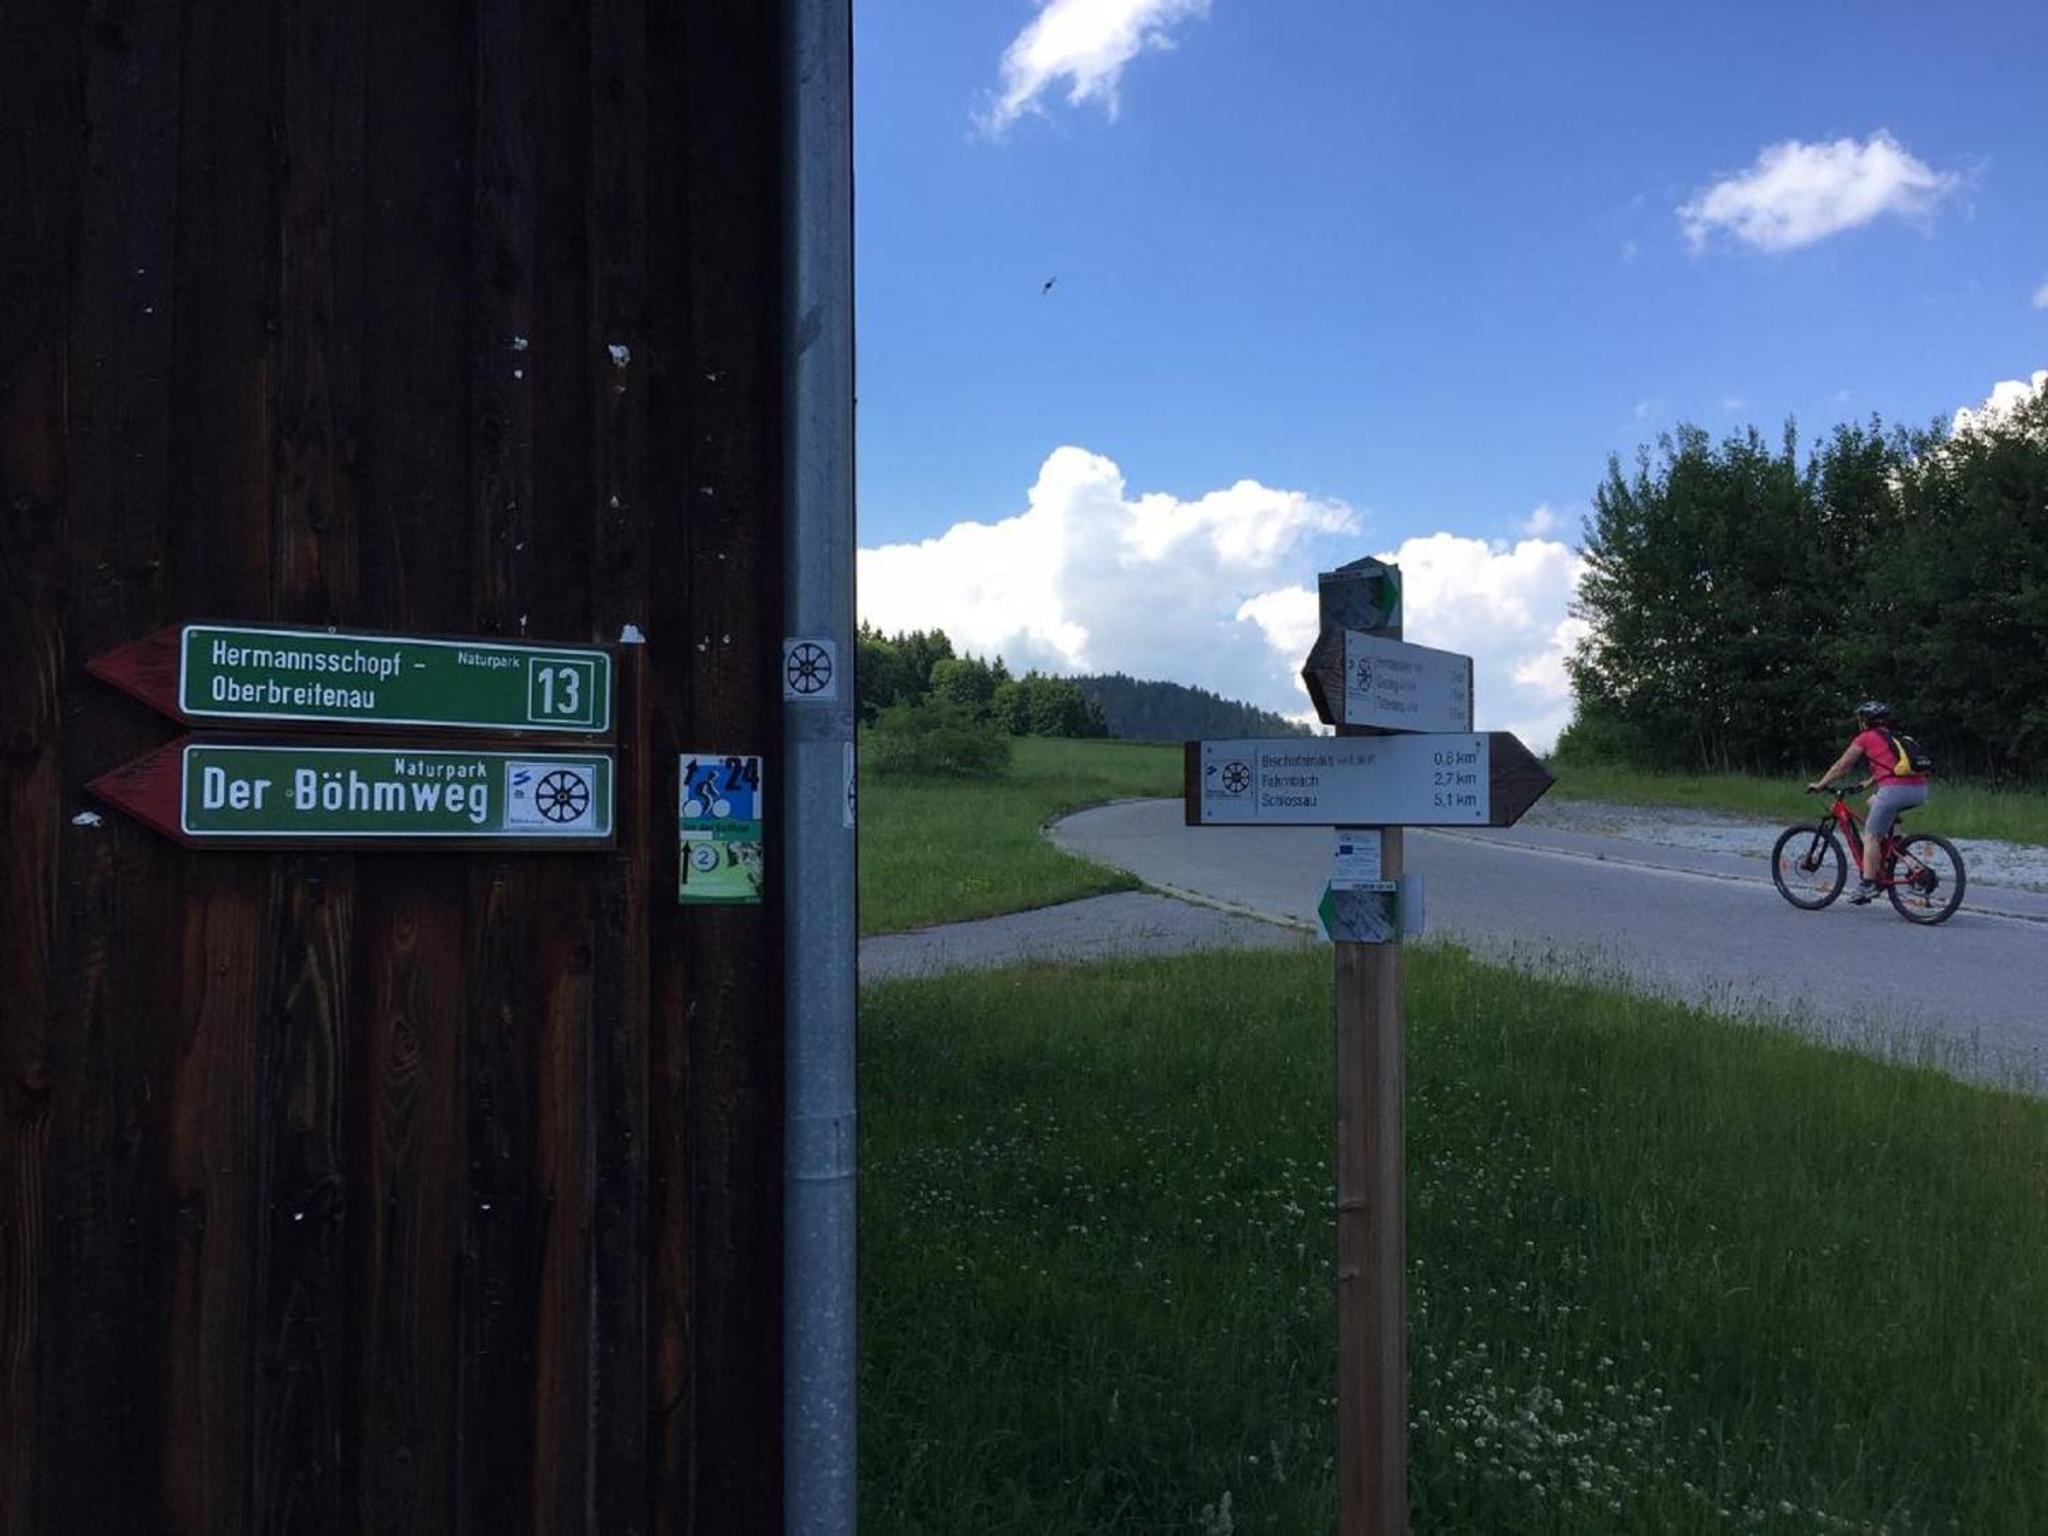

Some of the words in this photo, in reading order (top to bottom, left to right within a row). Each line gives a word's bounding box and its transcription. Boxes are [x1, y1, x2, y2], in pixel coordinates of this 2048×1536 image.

[211, 640, 401, 681] Hermannsschopf
[457, 650, 520, 670] Naturpark
[211, 675, 376, 709] Oberbreitenau
[538, 666, 580, 715] 13
[394, 758, 488, 780] Naturpark
[1456, 752, 1476, 765] km
[724, 757, 759, 793] 24
[1456, 772, 1476, 785] km
[203, 766, 272, 810] Der
[294, 768, 489, 824] Böhmweg
[1456, 793, 1477, 807] km
[698, 851, 710, 866] 2
